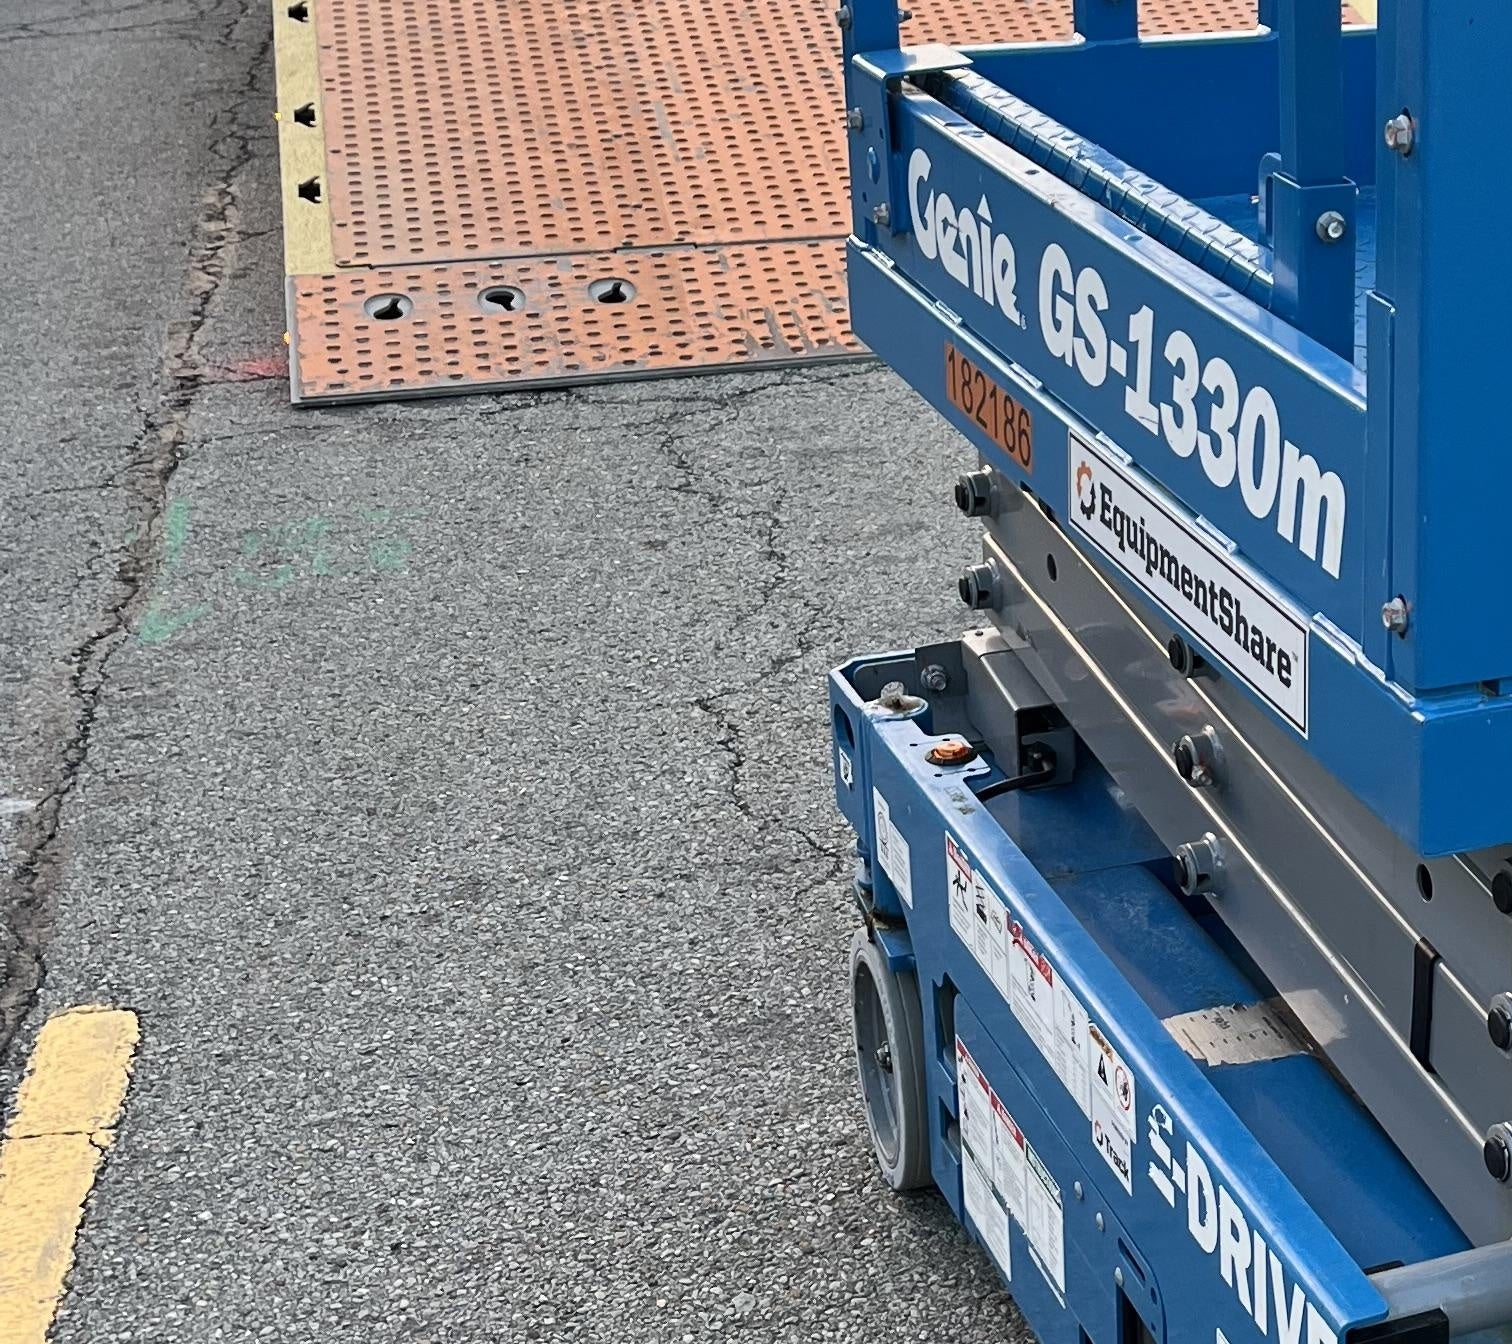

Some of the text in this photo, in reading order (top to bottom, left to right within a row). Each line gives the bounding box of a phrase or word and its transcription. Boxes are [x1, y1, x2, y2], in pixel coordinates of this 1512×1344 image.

[908, 148, 1346, 580] Genie GS-1330m
[946, 350, 1032, 471] 182186
[1100, 482, 1292, 688] EquipmentShare
[1105, 1134, 1129, 1183] Track
